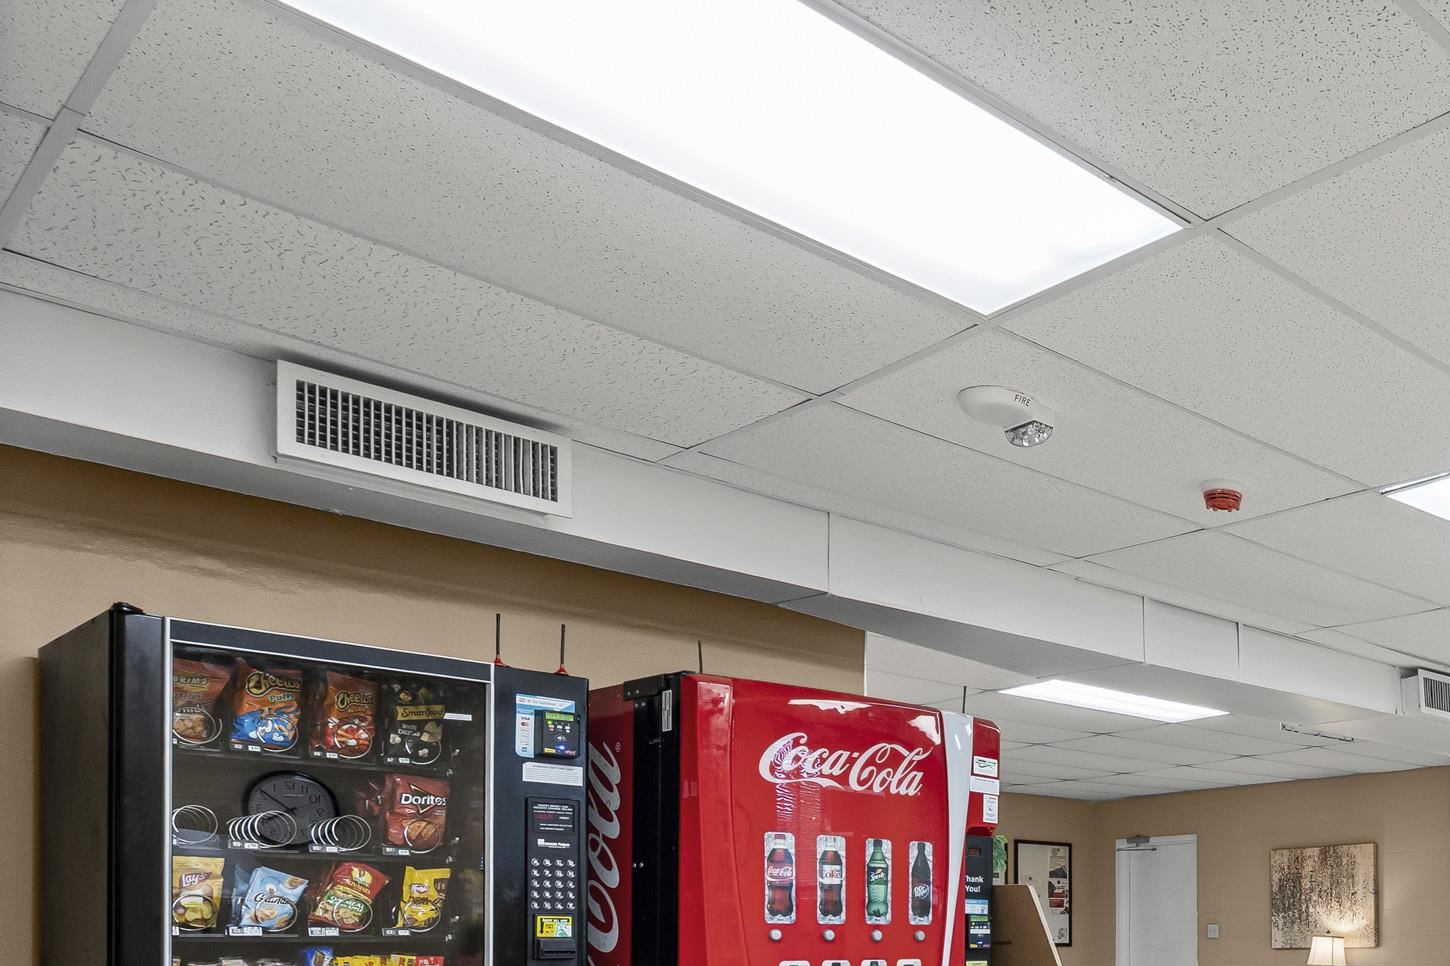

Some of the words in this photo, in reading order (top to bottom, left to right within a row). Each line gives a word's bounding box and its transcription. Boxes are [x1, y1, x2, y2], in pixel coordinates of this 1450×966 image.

[1014, 394, 1031, 407] FIRE
[758, 732, 935, 797] Coca-Cola
[401, 793, 446, 806] Doritos
[965, 885, 981, 893] You!
